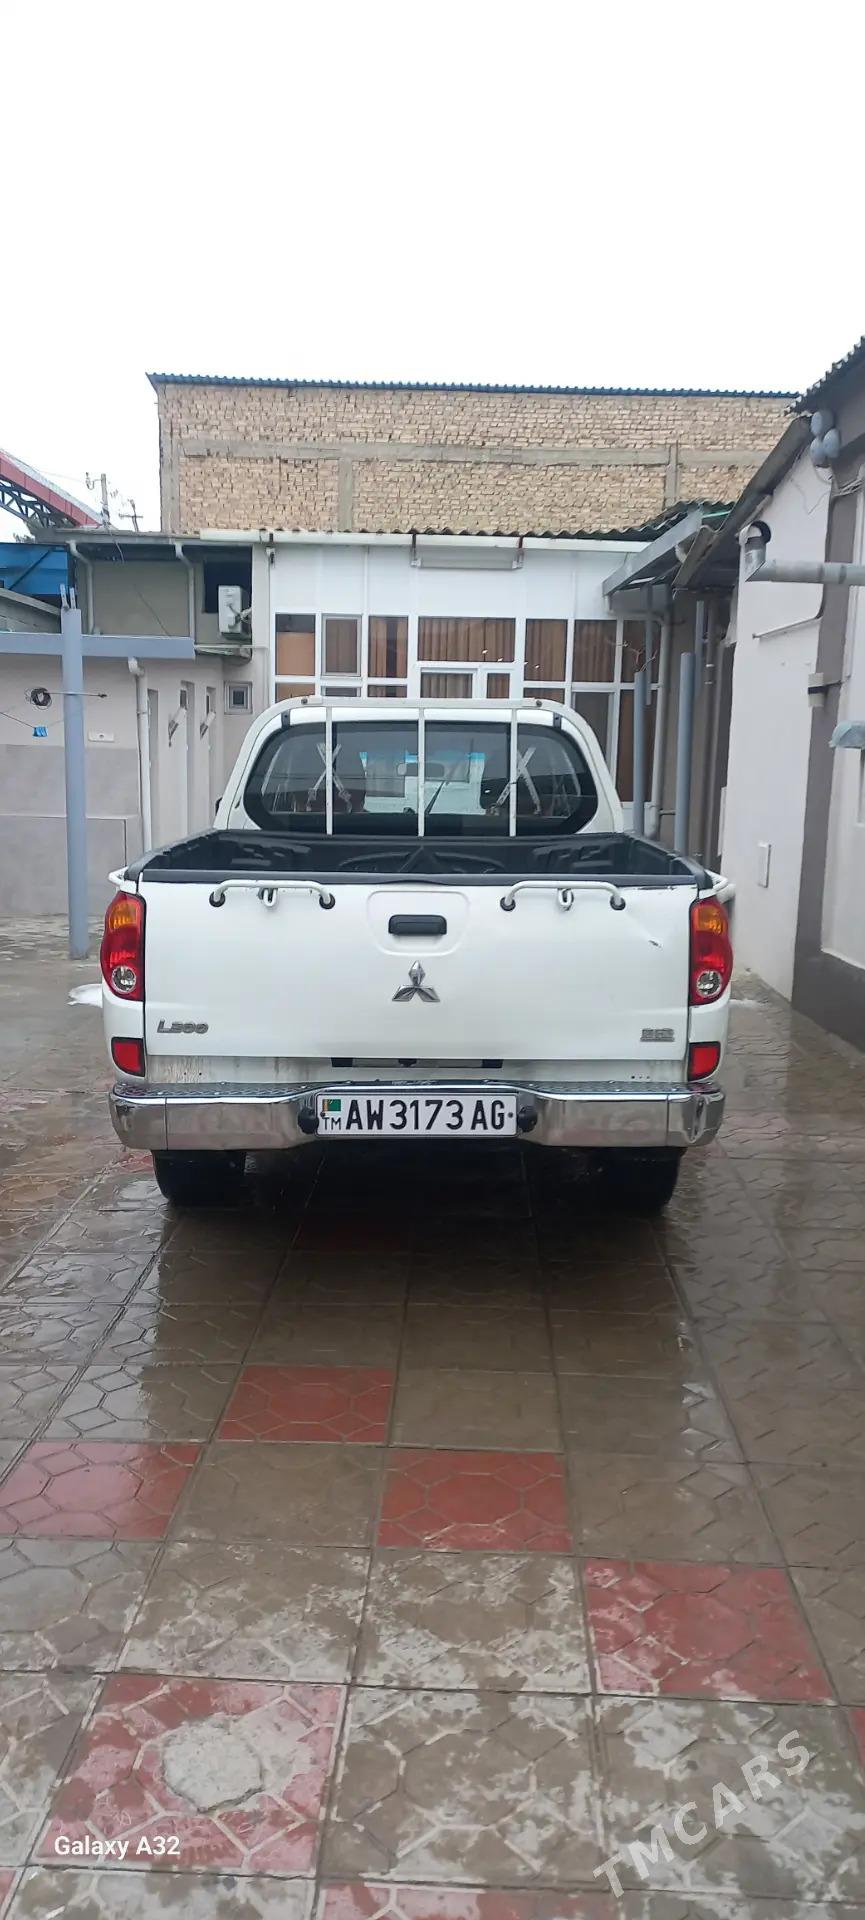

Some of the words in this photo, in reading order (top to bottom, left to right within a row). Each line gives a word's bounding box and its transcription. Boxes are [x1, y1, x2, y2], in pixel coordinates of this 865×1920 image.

[323, 1116, 342, 1130] TM
[345, 1099, 384, 1130] AW
[389, 1099, 464, 1130] 3173
[471, 1099, 505, 1130] AG
